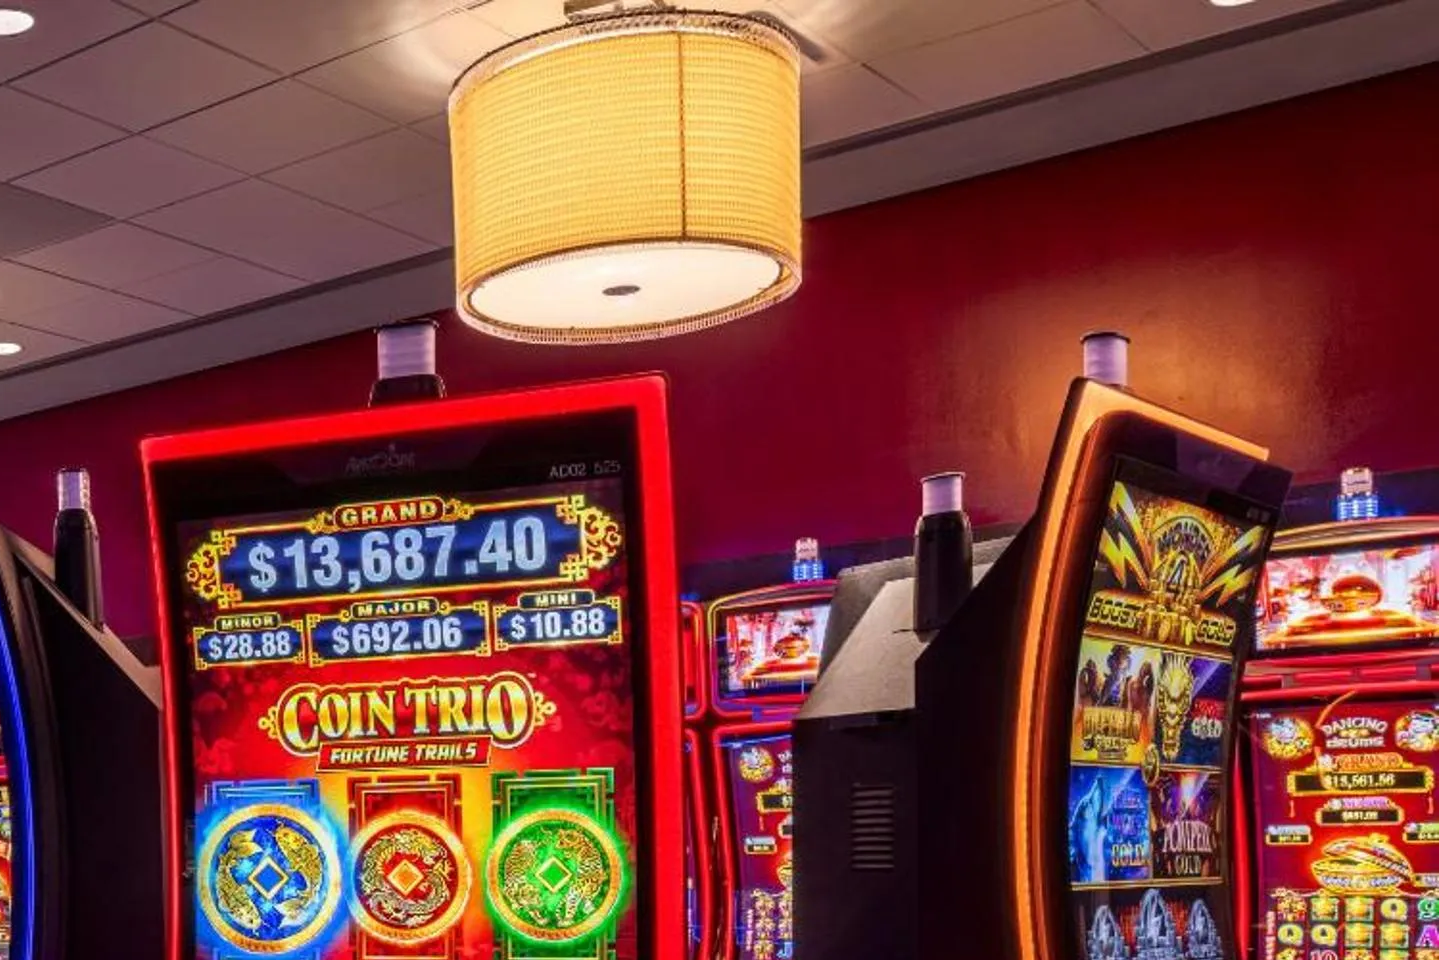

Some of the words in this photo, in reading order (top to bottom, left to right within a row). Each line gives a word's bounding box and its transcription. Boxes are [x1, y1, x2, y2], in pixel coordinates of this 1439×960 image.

[340, 498, 439, 526] GRAND
[249, 516, 547, 594] $13,687.40
[357, 600, 431, 618] MAJOR
[535, 592, 577, 607] MINI
[220, 614, 275, 630] MINOR
[332, 617, 462, 655] $692.06
[510, 606, 606, 640] $10.88
[208, 630, 291, 660] $28.88
[280, 684, 399, 750] COIN
[403, 677, 534, 745] TRIO
[329, 743, 409, 764] FORTUNE
[415, 741, 477, 762] TRAILS
